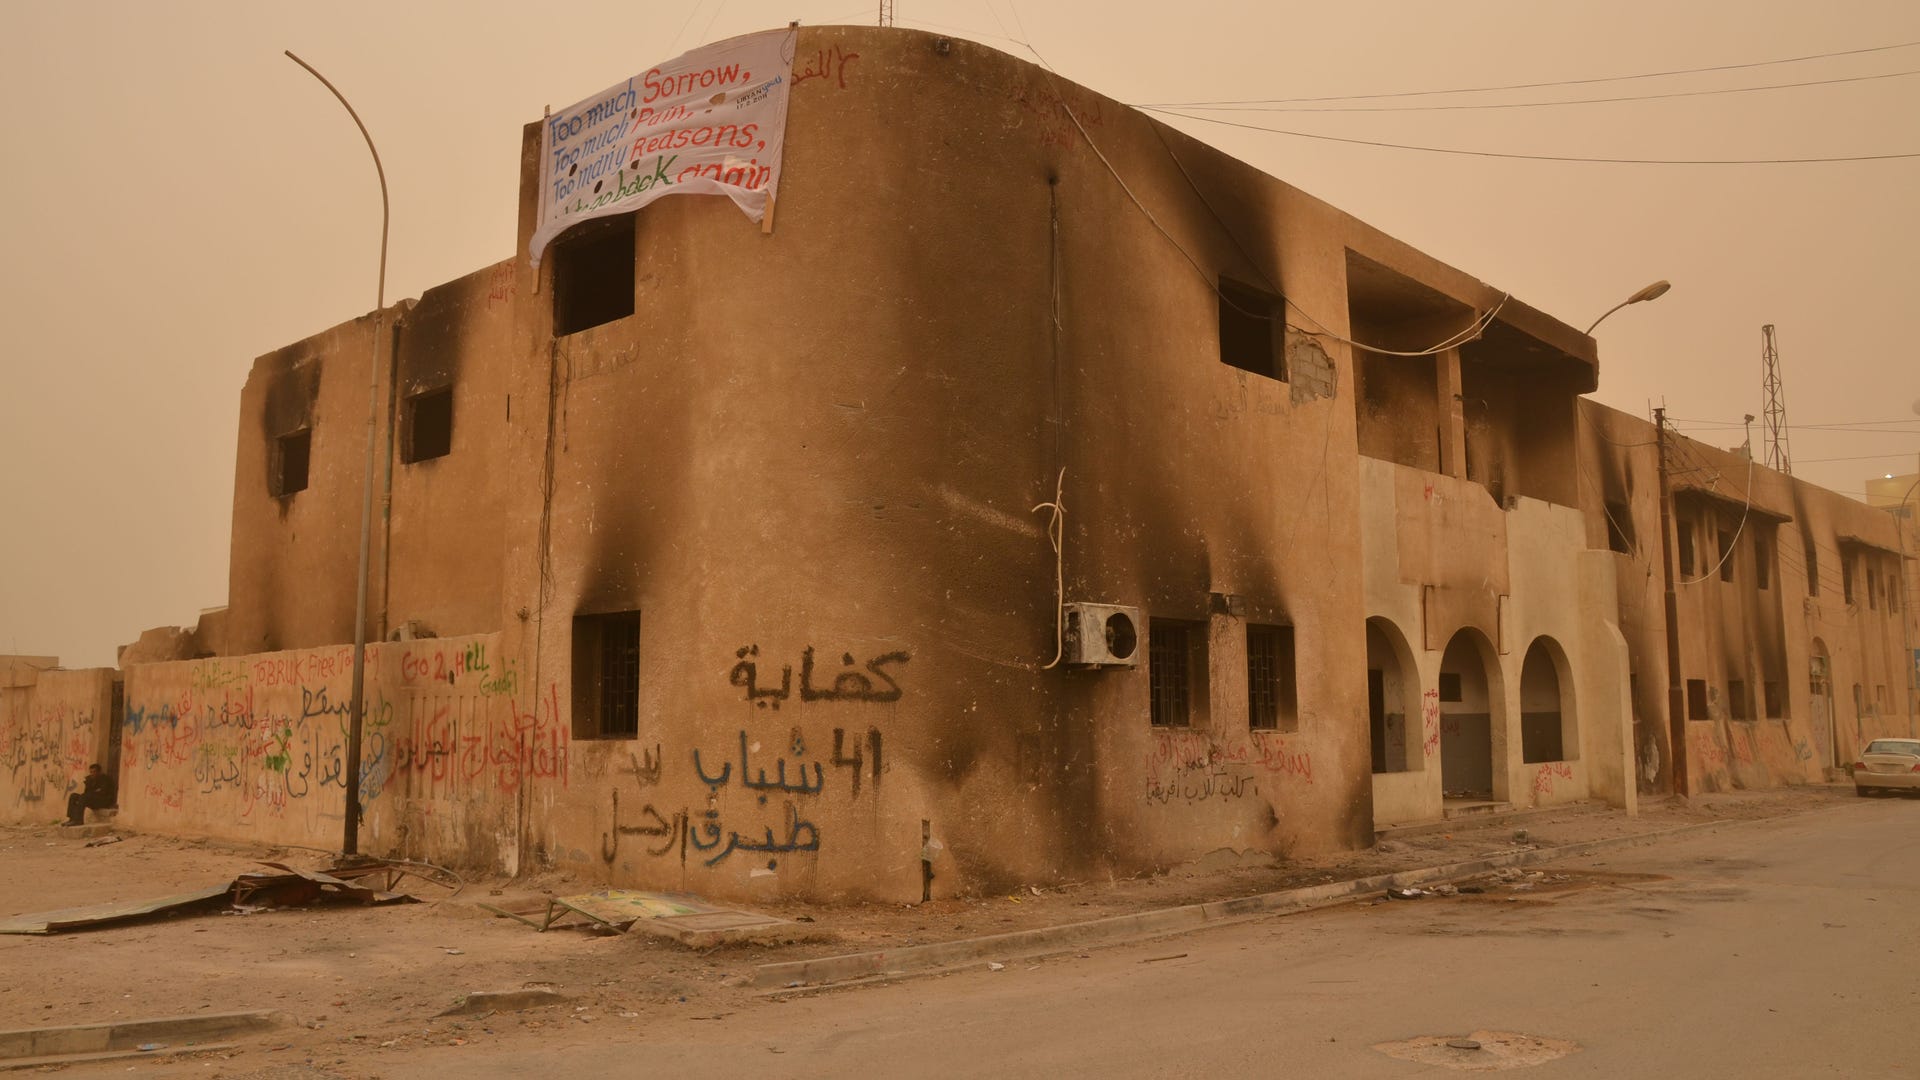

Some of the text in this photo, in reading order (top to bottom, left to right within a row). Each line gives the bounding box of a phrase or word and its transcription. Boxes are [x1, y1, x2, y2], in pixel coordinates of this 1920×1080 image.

[549, 63, 752, 147] Too much Sorrow,
[553, 106, 694, 175] Too much Pain,
[553, 123, 767, 207] Too many Reasons,
[307, 654, 336, 682] Free
[337, 647, 379, 681] Toy
[434, 651, 447, 680] 2
[730, 644, 910, 710] كفاية
[694, 727, 824, 804] شباب
[691, 802, 820, 870] طبرق
